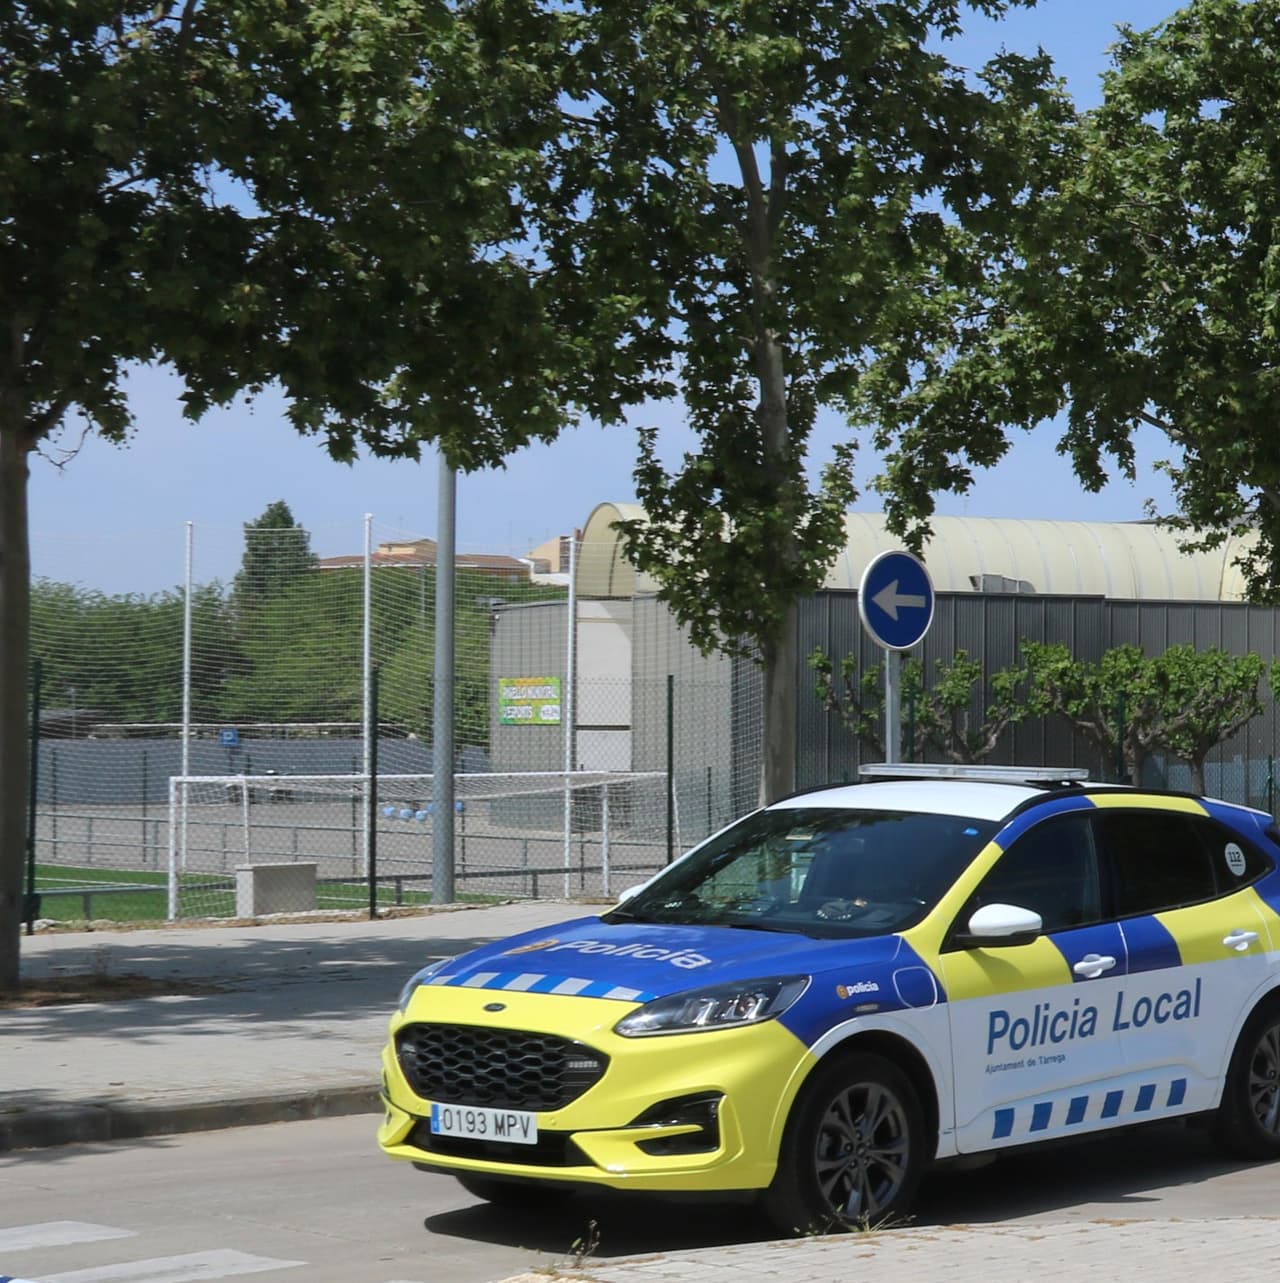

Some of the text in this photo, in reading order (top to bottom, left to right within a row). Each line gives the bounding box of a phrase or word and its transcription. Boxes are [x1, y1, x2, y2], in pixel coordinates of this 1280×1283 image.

[1228, 851, 1241, 862] 112
[847, 981, 879, 996] policia
[987, 977, 1202, 1055] Policia Local
[985, 1060, 1025, 1074] Ajuntament
[1027, 1058, 1037, 1067] de
[443, 1108, 530, 1138] 0193 MPV
